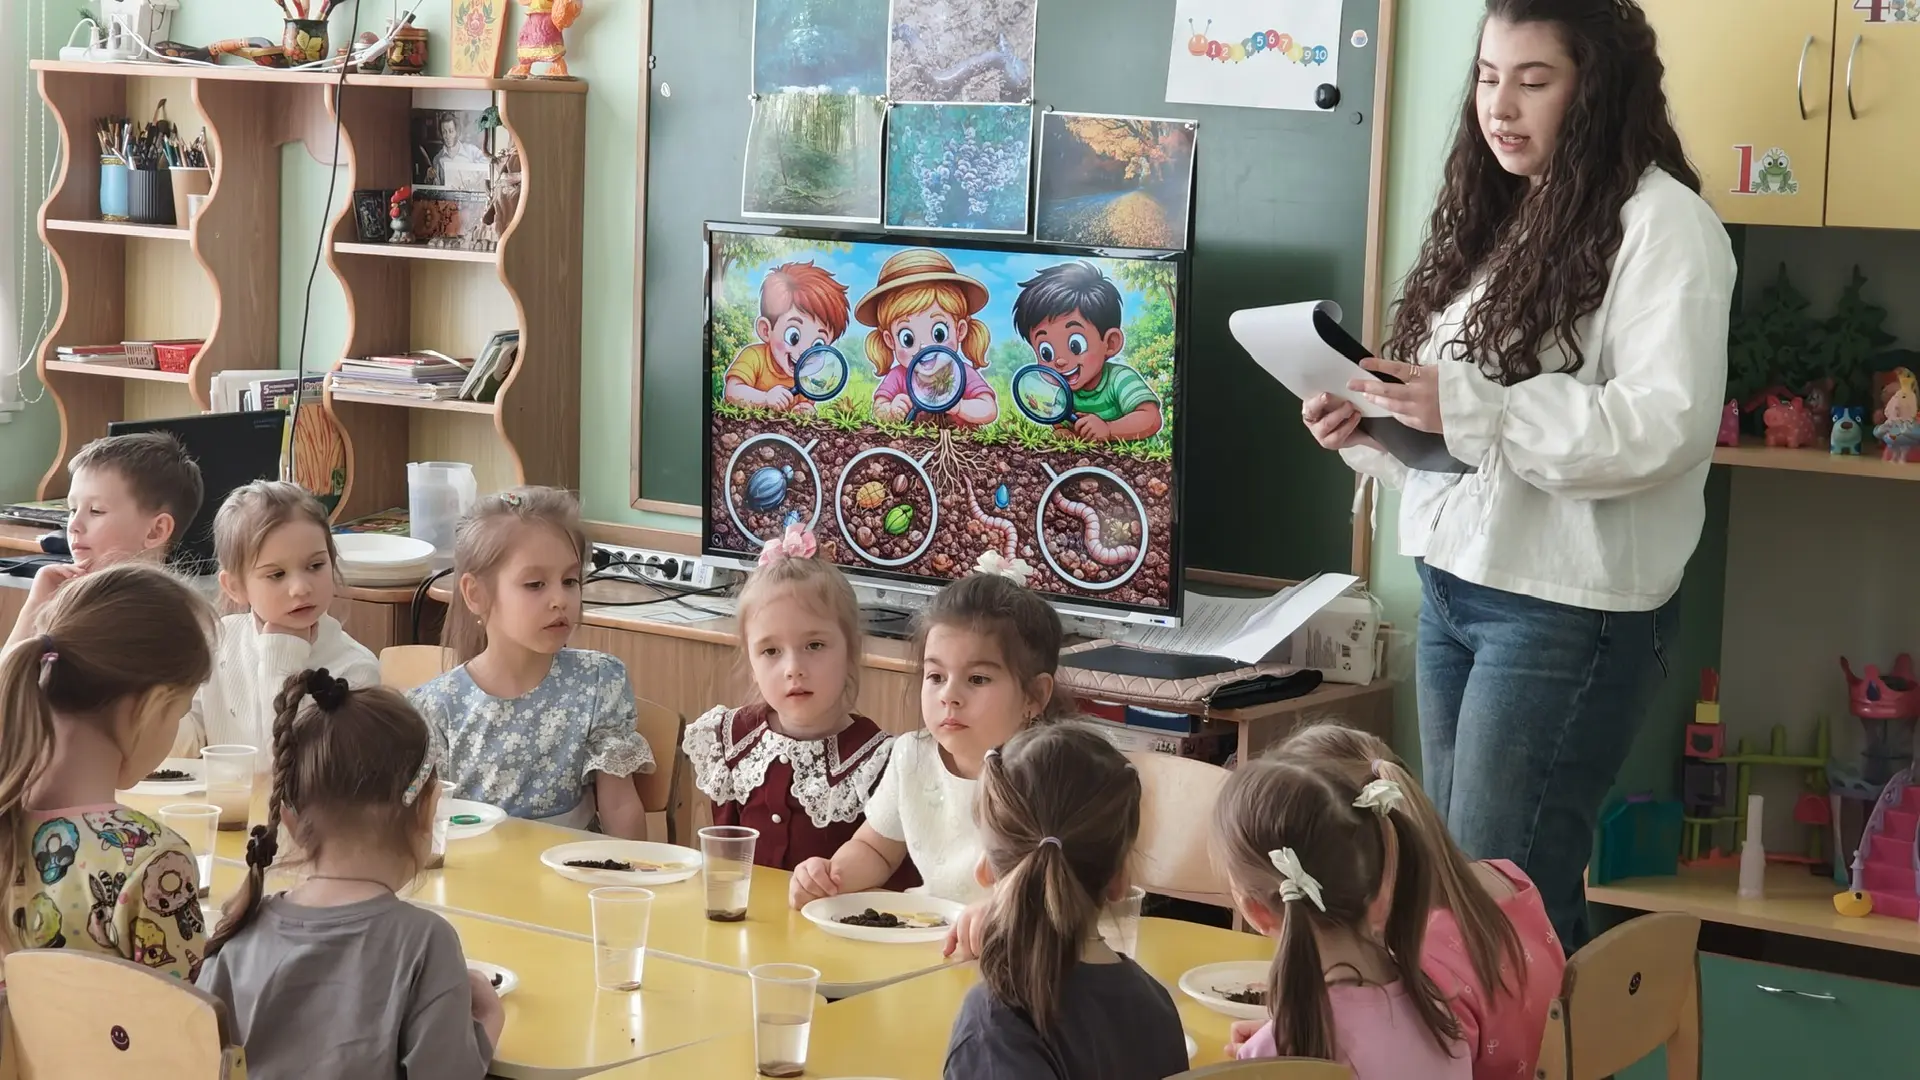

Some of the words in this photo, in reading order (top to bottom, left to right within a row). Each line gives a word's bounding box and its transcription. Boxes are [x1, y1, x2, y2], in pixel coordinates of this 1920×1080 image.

[1853, 0, 1890, 22] 4
[1256, 35, 1264, 46] 5
[1315, 50, 1327, 60] 10
[1731, 146, 1757, 193] 1
[263, 384, 269, 394] 5
